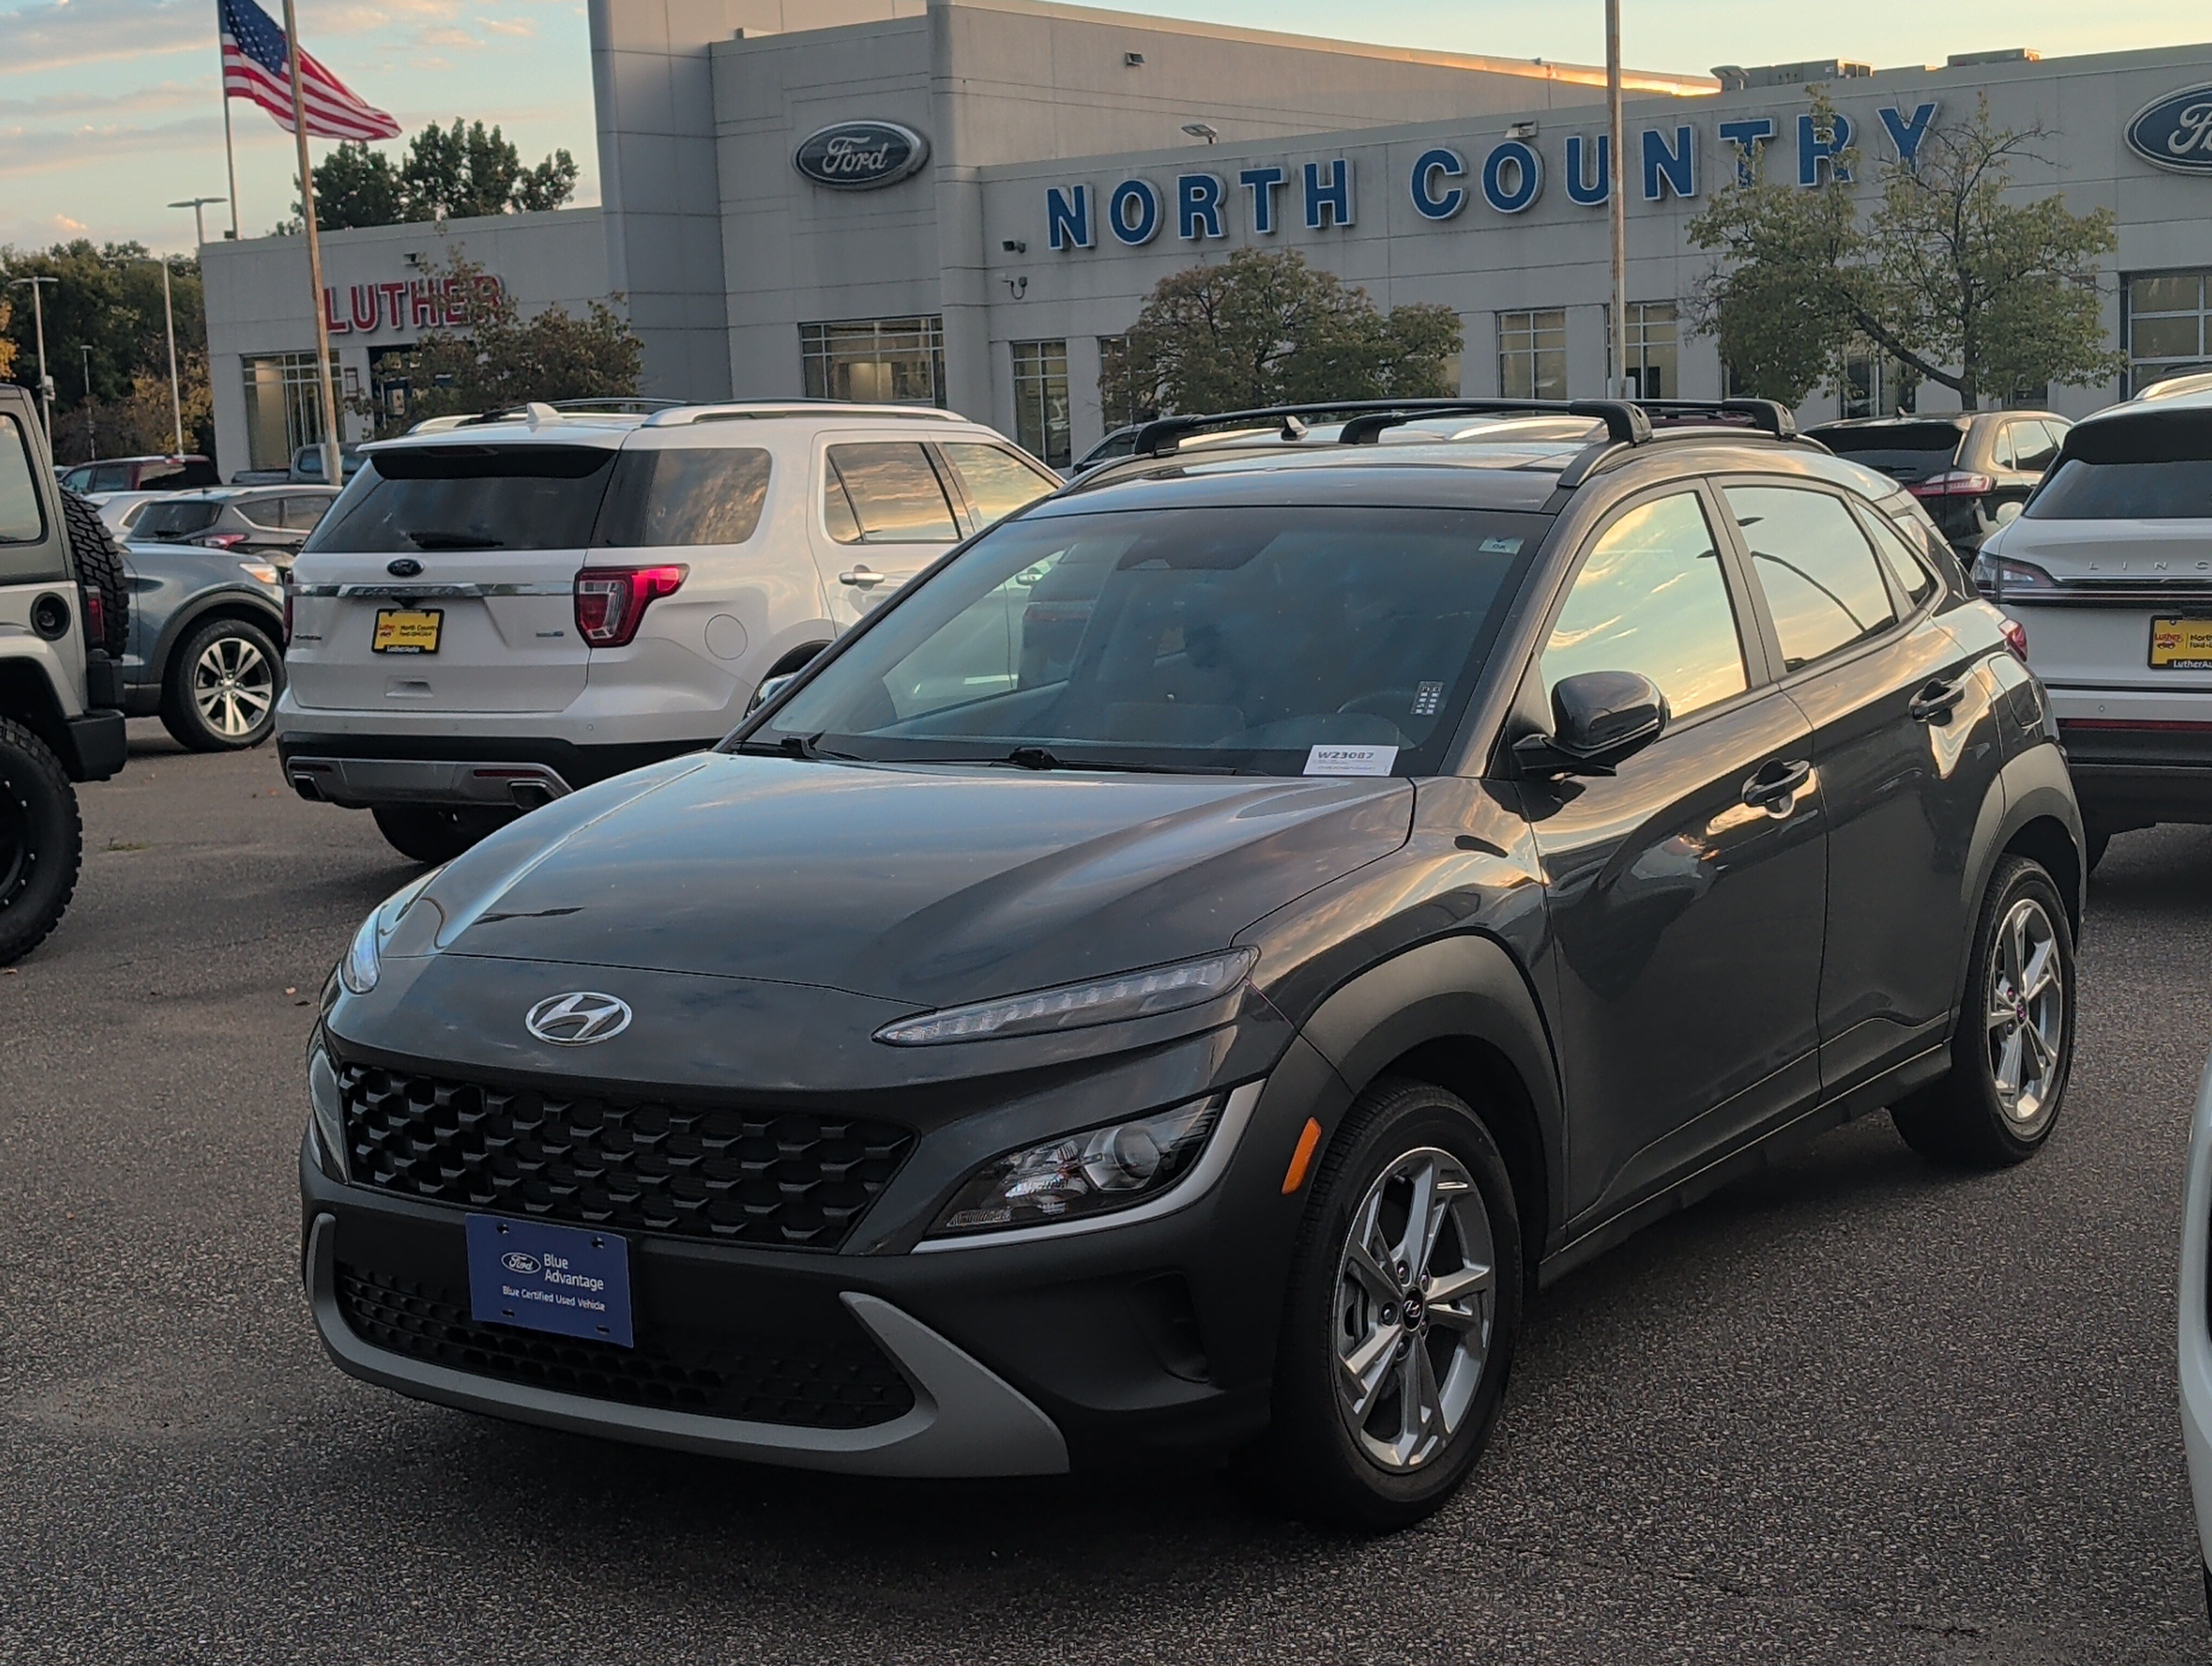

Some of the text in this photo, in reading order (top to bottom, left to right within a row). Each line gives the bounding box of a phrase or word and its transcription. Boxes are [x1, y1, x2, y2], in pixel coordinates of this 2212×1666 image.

[822, 136, 889, 174] Ford
[1045, 102, 1939, 251] NORTH COUNTRY
[324, 275, 505, 334] LUTHER
[509, 1254, 533, 1271] Ford
[544, 1253, 568, 1269] Blue
[545, 1270, 604, 1291] Advantage
[502, 1285, 606, 1312] Blue Certified Used Vehicle
